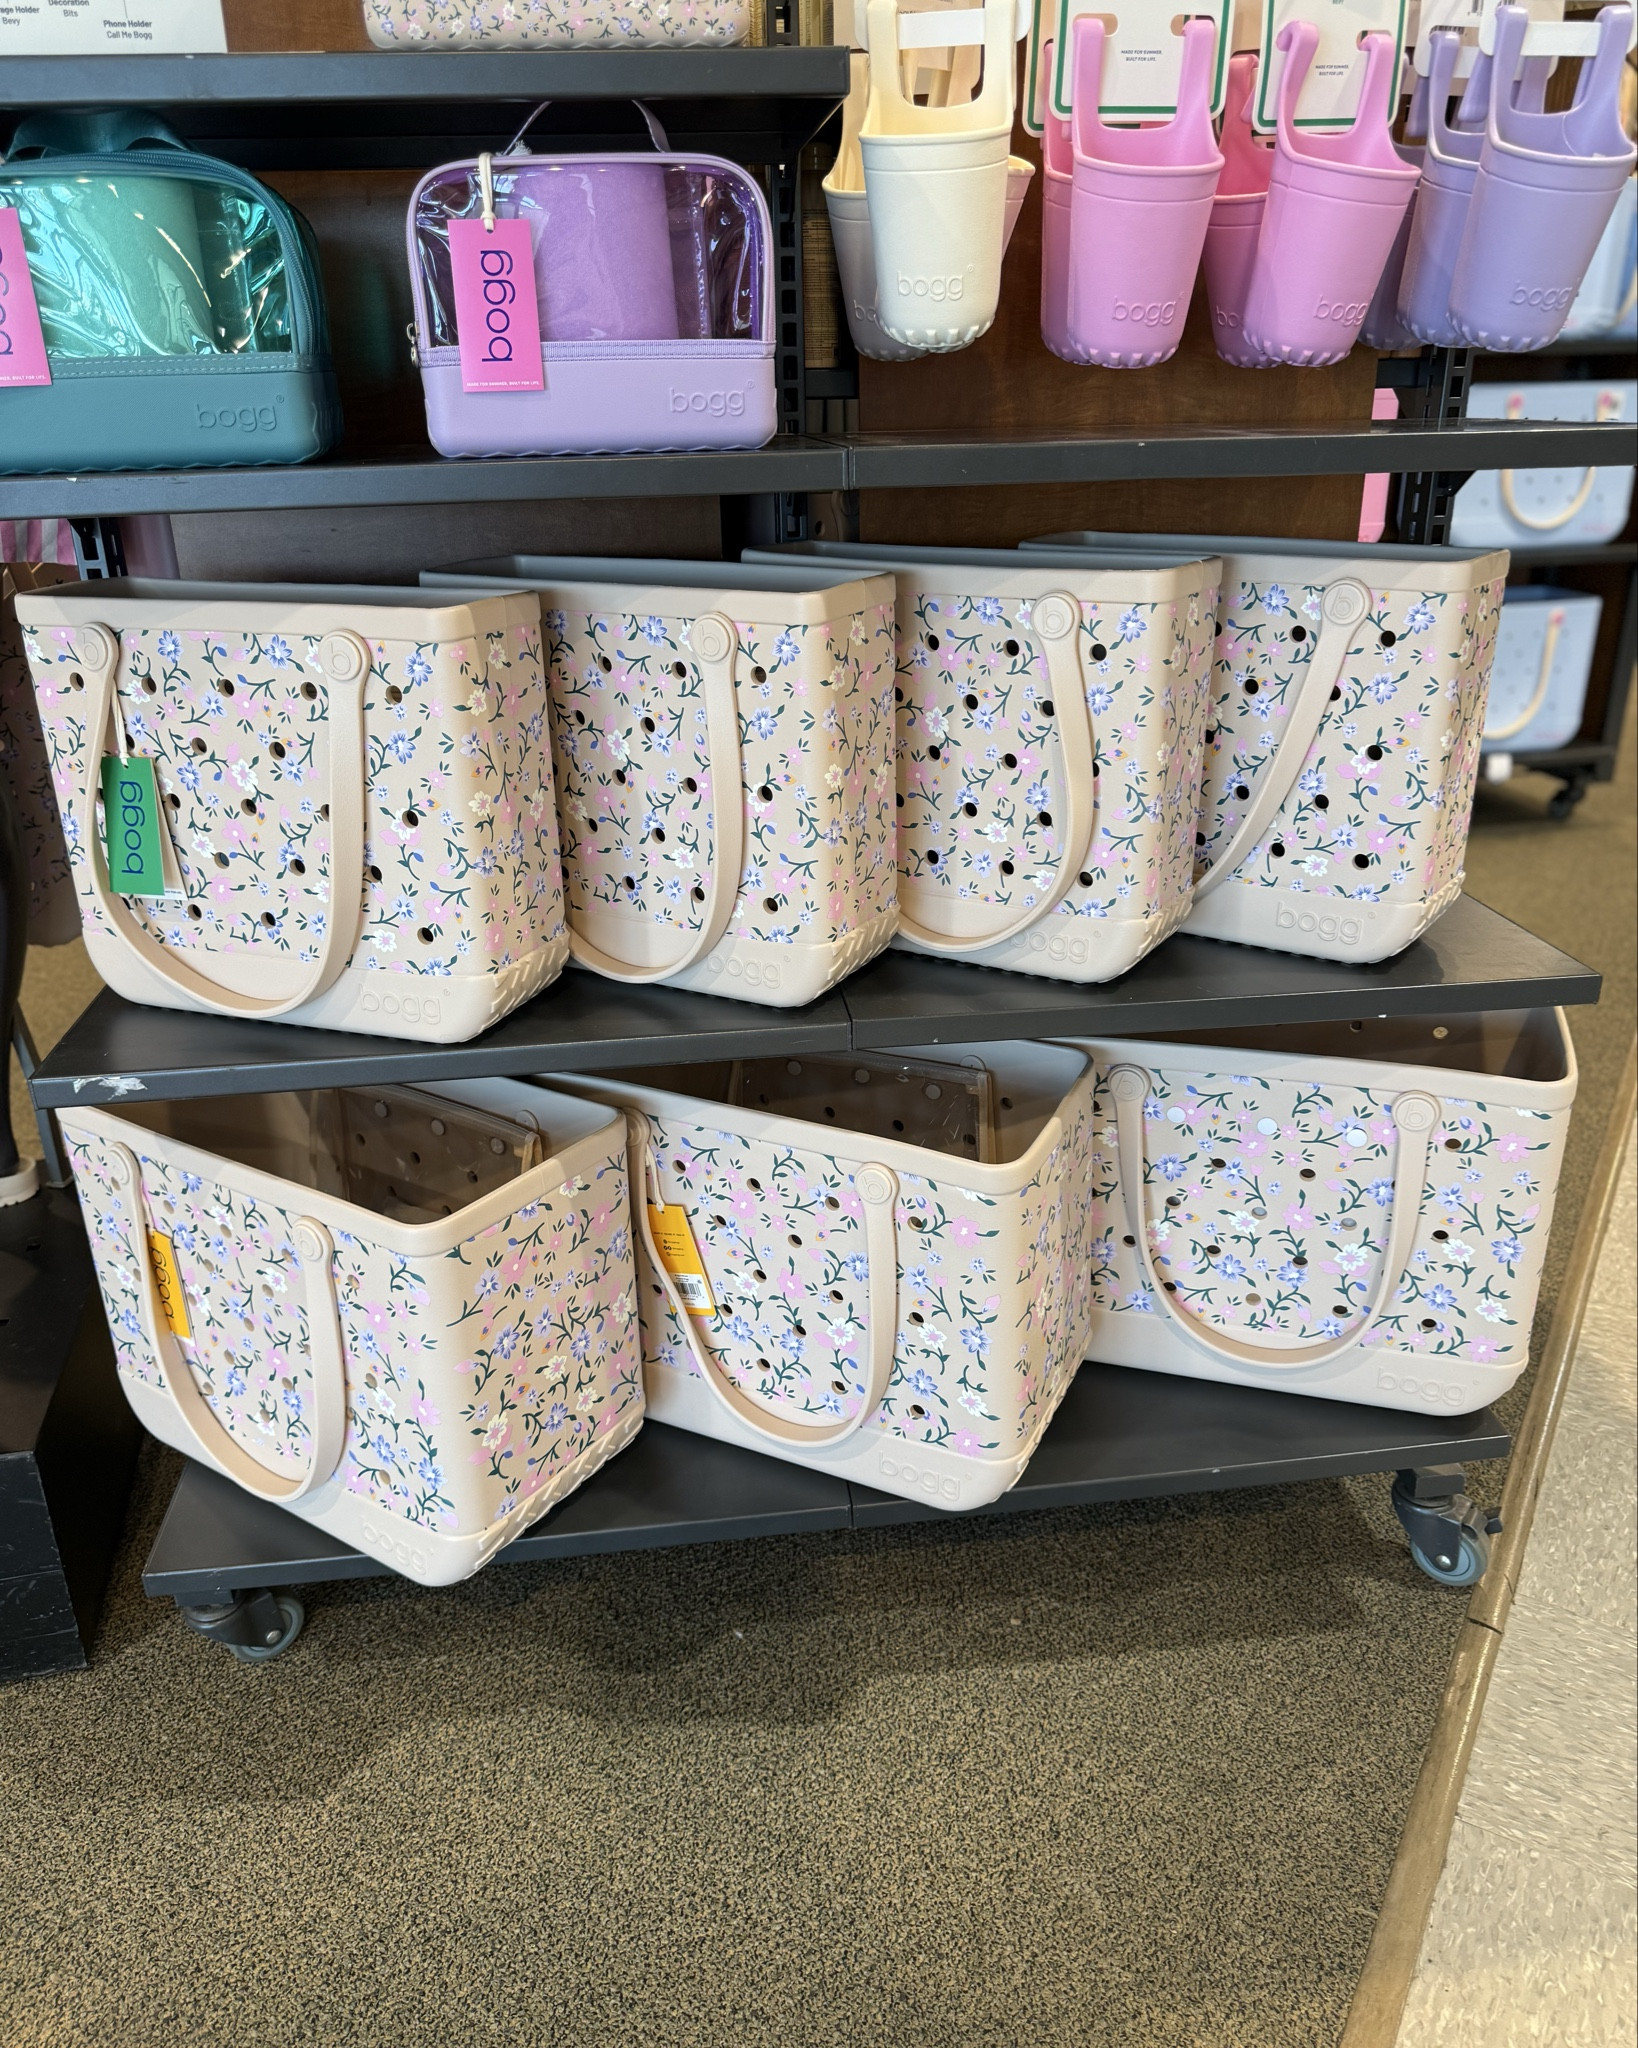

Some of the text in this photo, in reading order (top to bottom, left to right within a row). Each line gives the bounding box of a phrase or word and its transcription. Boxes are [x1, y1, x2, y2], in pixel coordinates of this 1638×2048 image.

[2, 16, 20, 26] Bevy
[15, 6, 40, 14] Holder
[63, 9, 78, 17] Bits
[103, 20, 152, 28] Phone Holder
[106, 31, 153, 40] Call Me Bogg
[897, 270, 963, 302] bogg
[1510, 280, 1573, 312] bogg
[480, 250, 516, 362] bogg
[853, 299, 877, 322] bo
[1112, 295, 1176, 327] bogg
[1216, 305, 1240, 328] bo
[1313, 294, 1369, 327] bogg
[196, 403, 278, 433] bogg
[669, 386, 745, 418] bogg
[120, 780, 146, 874] bogg
[1276, 901, 1363, 945] bogg
[358, 982, 441, 1026] bogg
[151, 1246, 175, 1319] bogg
[1376, 1366, 1467, 1408] bogg
[880, 1450, 960, 1501] bogg
[360, 1514, 428, 1576] bogg
